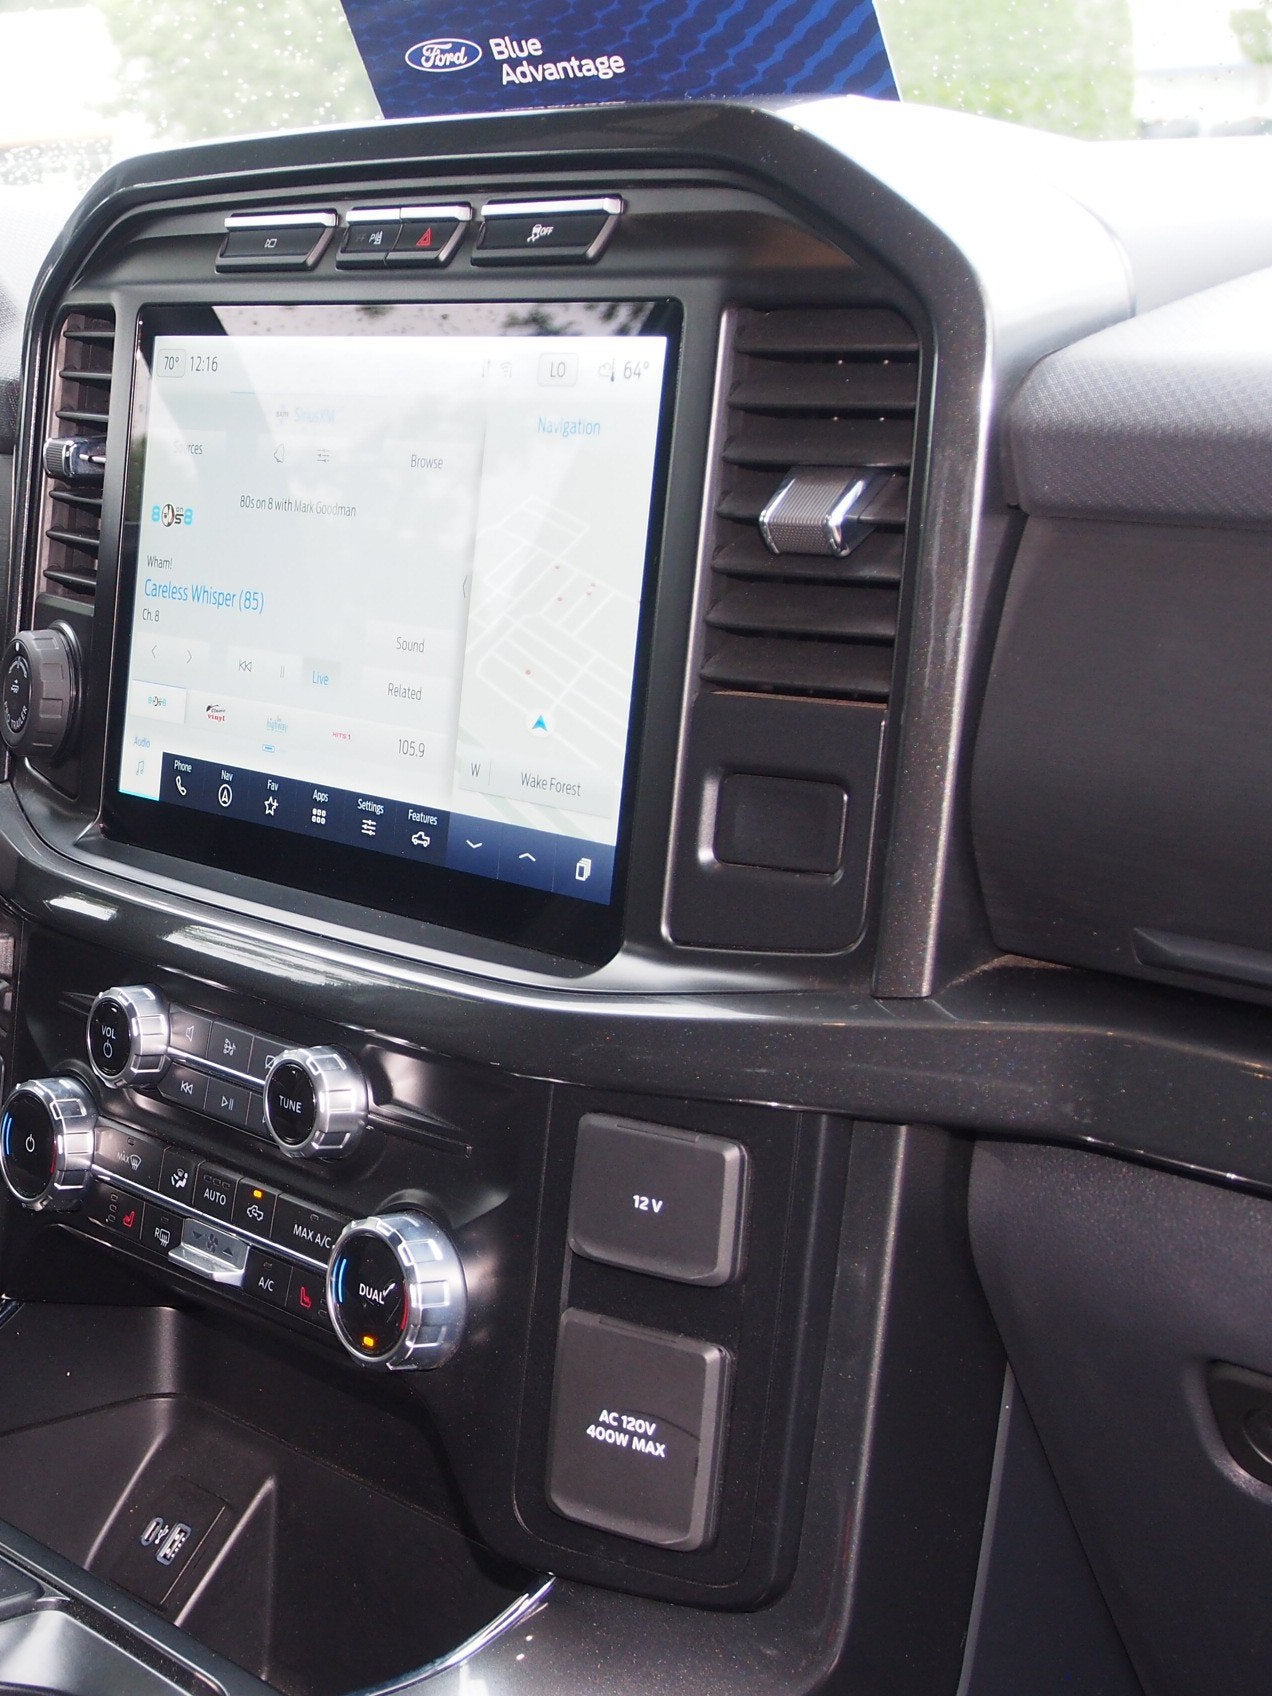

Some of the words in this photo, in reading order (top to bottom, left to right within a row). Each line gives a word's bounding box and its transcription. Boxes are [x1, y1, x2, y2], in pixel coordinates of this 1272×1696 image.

[421, 43, 468, 68] Ford
[488, 36, 543, 60] Blue
[501, 54, 626, 85] Advantage
[539, 226, 554, 237] OFF
[163, 356, 180, 371] 70°
[190, 356, 218, 372] 12:16
[549, 361, 566, 378] LO
[622, 361, 650, 379] 64°
[537, 416, 601, 438] Navigation
[410, 454, 444, 470] Browse
[240, 495, 255, 509] 80s
[256, 499, 266, 510] on
[268, 498, 274, 511] 8
[274, 498, 293, 512] with
[294, 500, 314, 514] Mark
[316, 502, 357, 518] Goodman
[146, 555, 173, 569] Wham!
[144, 578, 188, 601] Careless
[191, 585, 236, 609] Whisper
[238, 590, 264, 614] (85)
[142, 608, 153, 621] Ch.
[154, 610, 160, 622] 8
[396, 636, 425, 653] Sound
[312, 671, 329, 686] Live
[387, 683, 422, 701] Related
[207, 714, 226, 722] vinyl
[133, 735, 151, 749] Audio
[332, 731, 348, 740] HITS
[398, 739, 425, 758] 105.9
[174, 759, 192, 773] Phone
[221, 769, 234, 782] Nav
[470, 763, 480, 777] W
[520, 772, 547, 791] Wake
[549, 777, 581, 797] Forest
[267, 779, 279, 791] Fav
[312, 788, 329, 803] Apps
[357, 798, 384, 815] Settings
[408, 809, 438, 826] Features
[101, 1025, 117, 1040] VOL
[279, 1096, 302, 1114] TUNE
[203, 1187, 227, 1206] AUTO
[633, 1195, 649, 1211] 12
[293, 1223, 314, 1242] MAX
[314, 1232, 332, 1249] A/C
[258, 1276, 274, 1292] A/C
[359, 1283, 385, 1305] DUAL
[599, 1410, 619, 1426] AC
[621, 1415, 656, 1436] 120V
[586, 1424, 629, 1447] 400W
[632, 1436, 666, 1457] MAX
